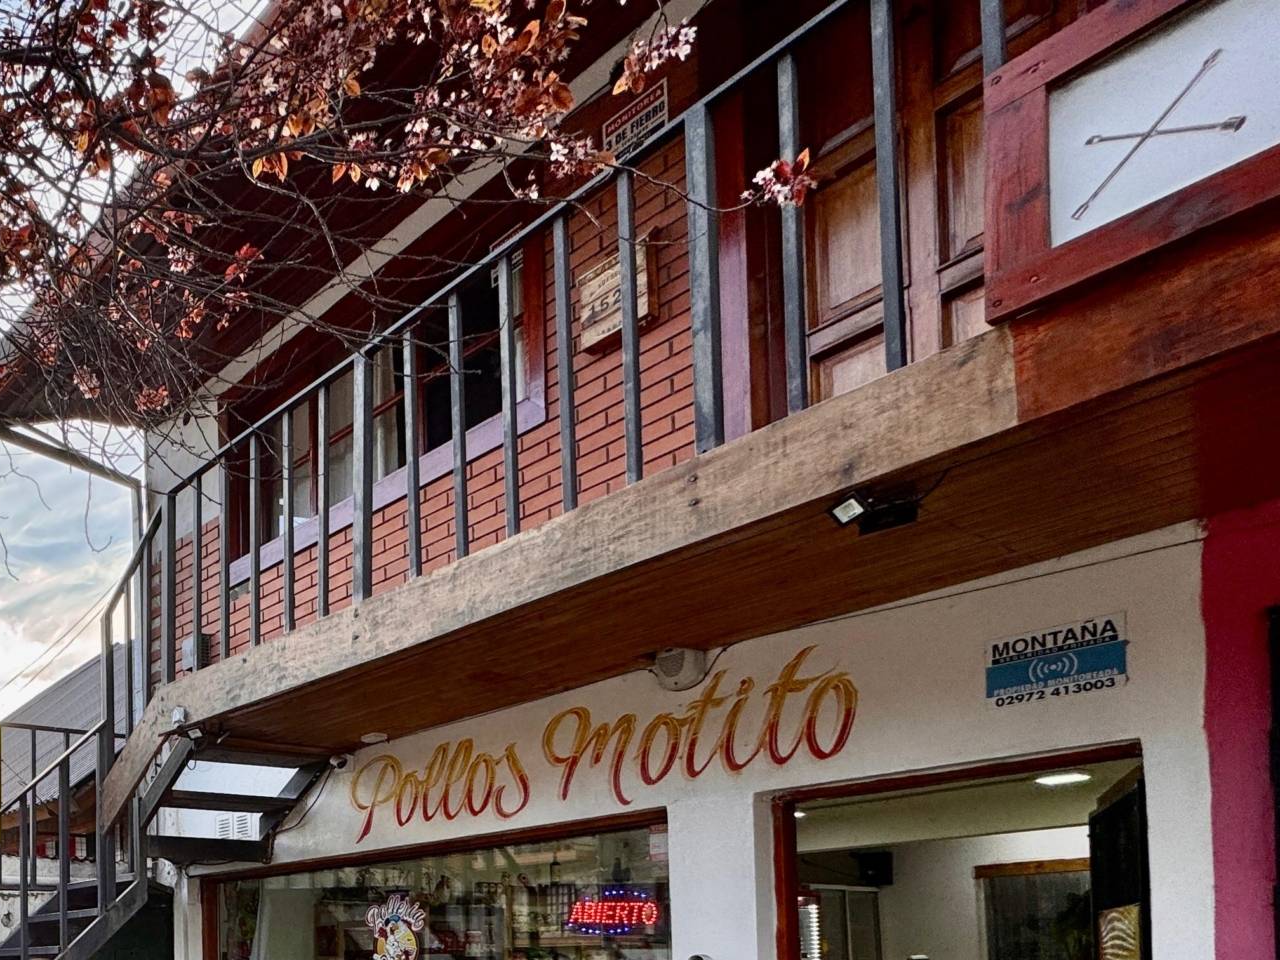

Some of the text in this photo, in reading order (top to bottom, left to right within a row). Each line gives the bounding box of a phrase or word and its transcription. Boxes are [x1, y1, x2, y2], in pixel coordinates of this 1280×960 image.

[607, 88, 662, 134] MONITOREA
[615, 128, 628, 145] DE
[630, 101, 665, 134] FIERRO
[992, 618, 1118, 659] MONTAÑA
[993, 681, 1046, 697] PROPIEDAD
[995, 677, 1116, 708] 02972 413003
[350, 644, 859, 844] Pollos Motito
[568, 900, 659, 926] ABIERTO
